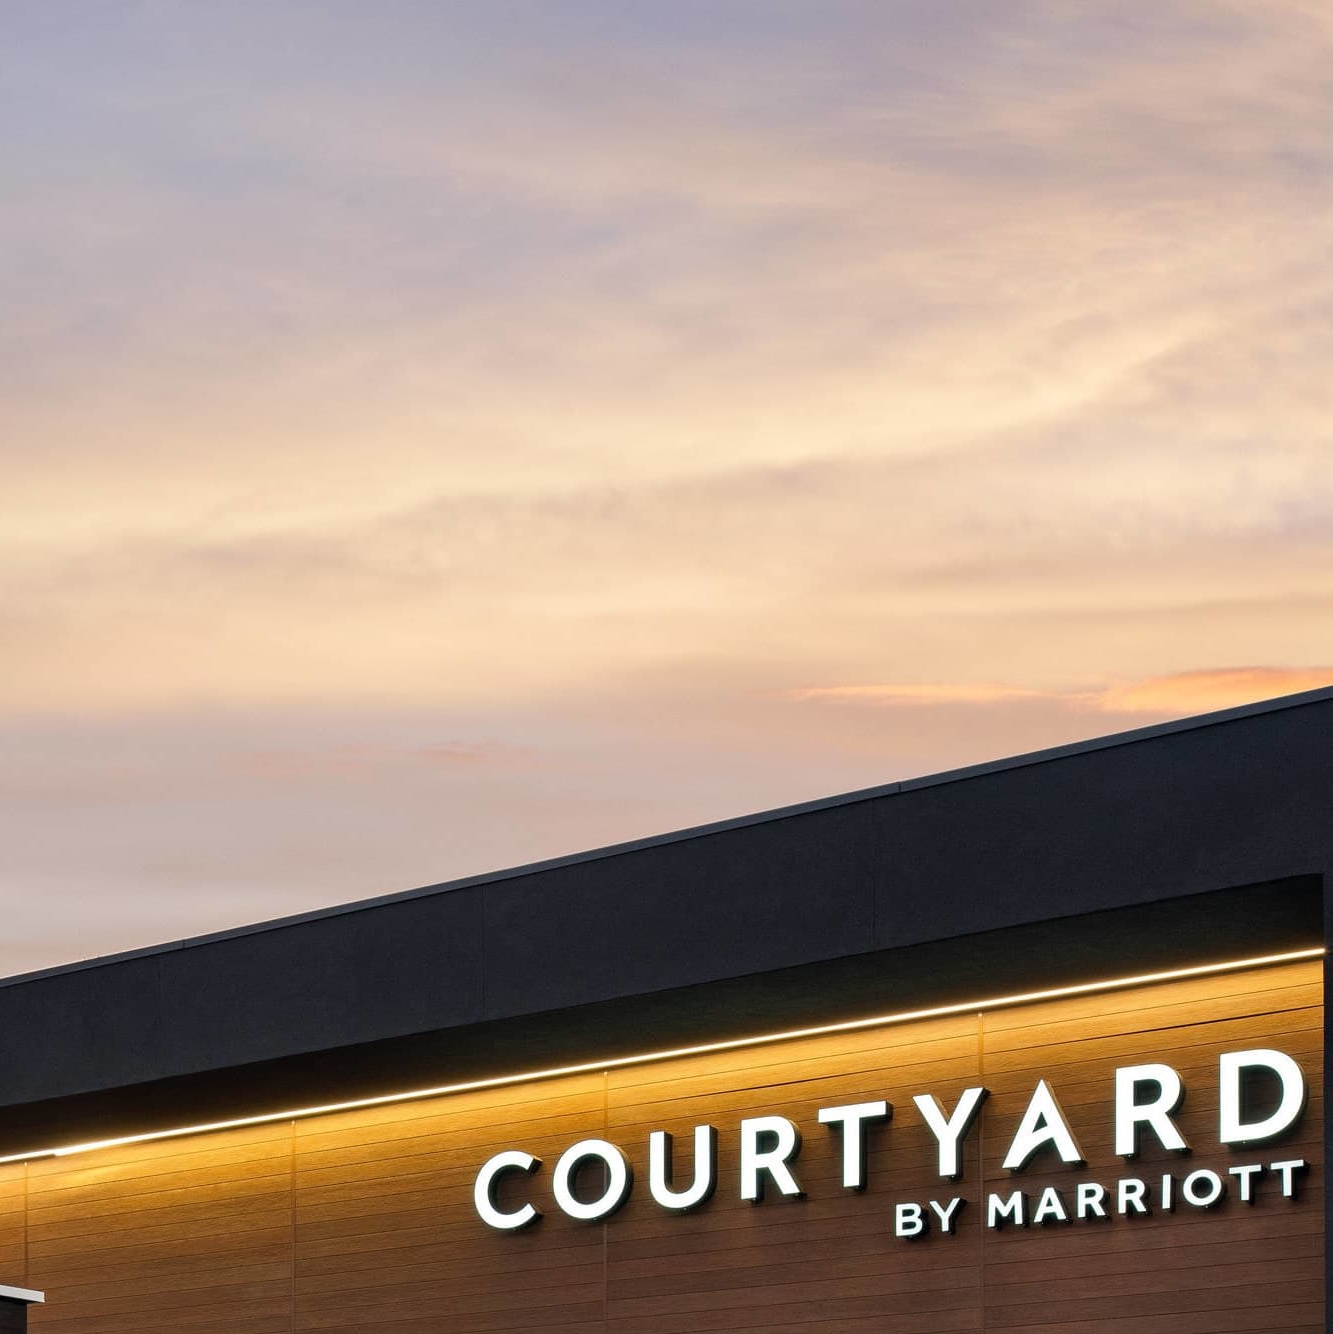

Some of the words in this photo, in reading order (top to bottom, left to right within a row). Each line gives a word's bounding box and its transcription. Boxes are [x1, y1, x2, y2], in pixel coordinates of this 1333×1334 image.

[473, 1047, 1307, 1230] COURTYARD
[894, 1196, 963, 1238] BY
[986, 1158, 1306, 1230] MARRIOTT
